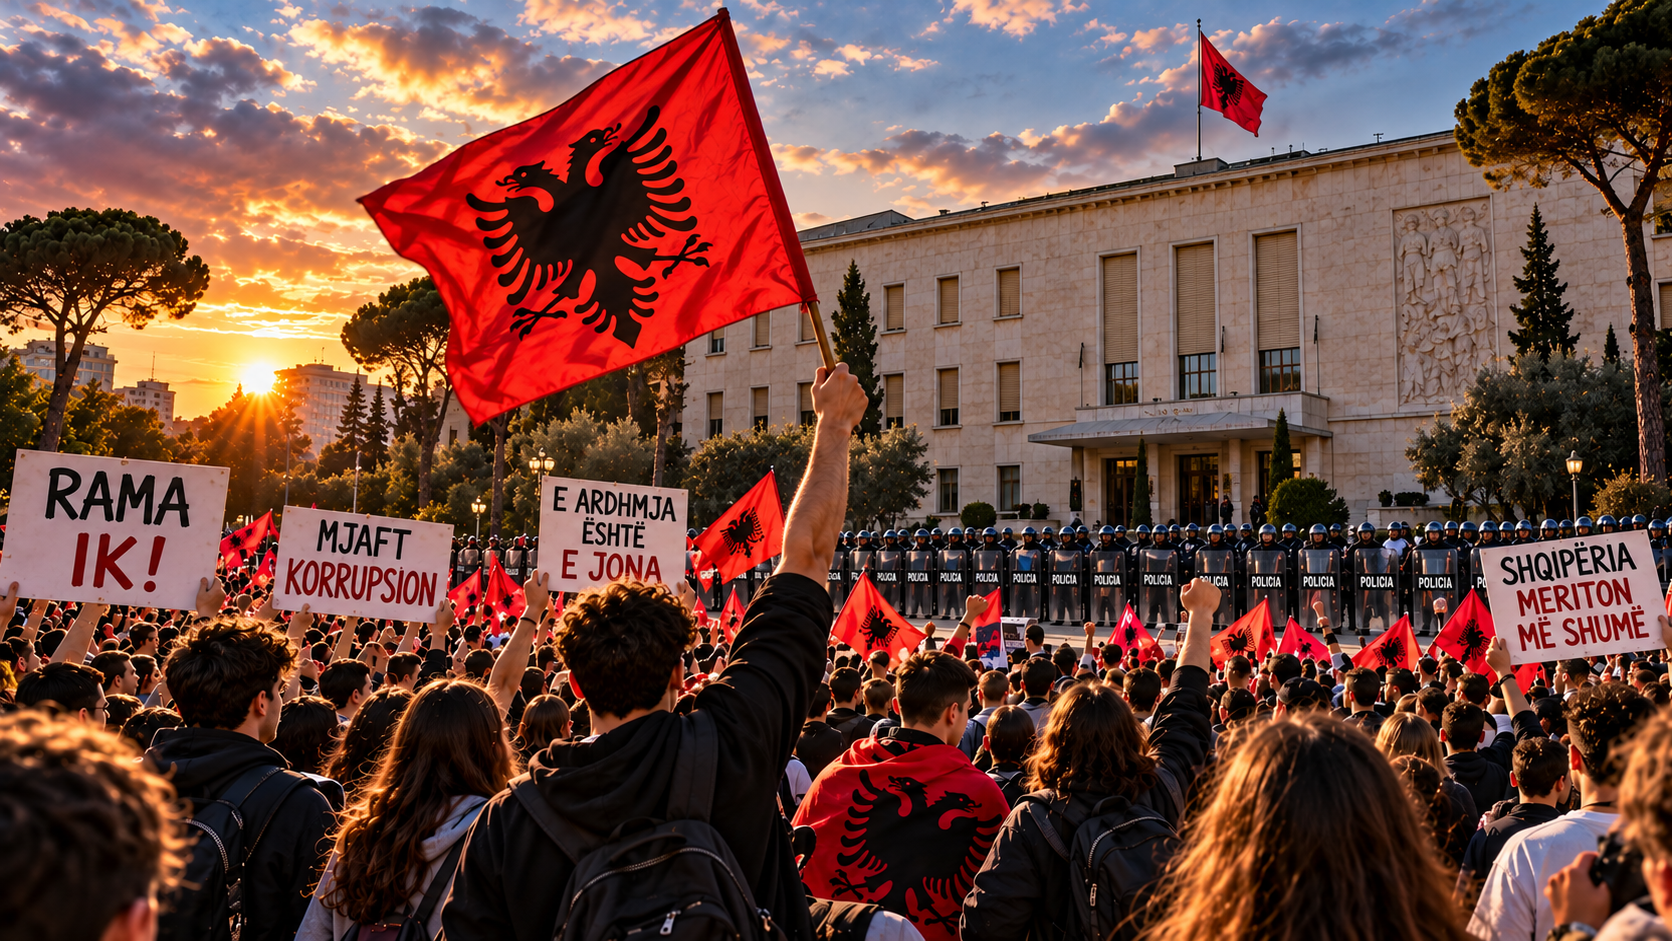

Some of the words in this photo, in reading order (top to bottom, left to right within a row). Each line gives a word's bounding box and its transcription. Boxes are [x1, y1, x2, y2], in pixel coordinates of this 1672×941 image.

[45, 467, 190, 528] RAMA
[553, 485, 569, 512] E
[575, 488, 677, 522] ARDHMJA
[316, 518, 412, 562] MJAFT
[582, 517, 646, 549] ËSHTË
[71, 532, 167, 593] IK!
[561, 549, 579, 580] E
[588, 551, 662, 583] JONA
[1051, 574, 1078, 585] POLICIA
[1094, 574, 1121, 586] POLICIA
[1143, 574, 1173, 586] POLICIA
[1251, 576, 1282, 588] POLICIA
[1303, 576, 1335, 588] POLICIA
[1360, 576, 1395, 588] POLICIA
[1418, 577, 1453, 589] POLICIA
[1516, 577, 1633, 616] MERITON
[1517, 616, 1557, 652] MË
[1562, 605, 1650, 647] SHUMË
